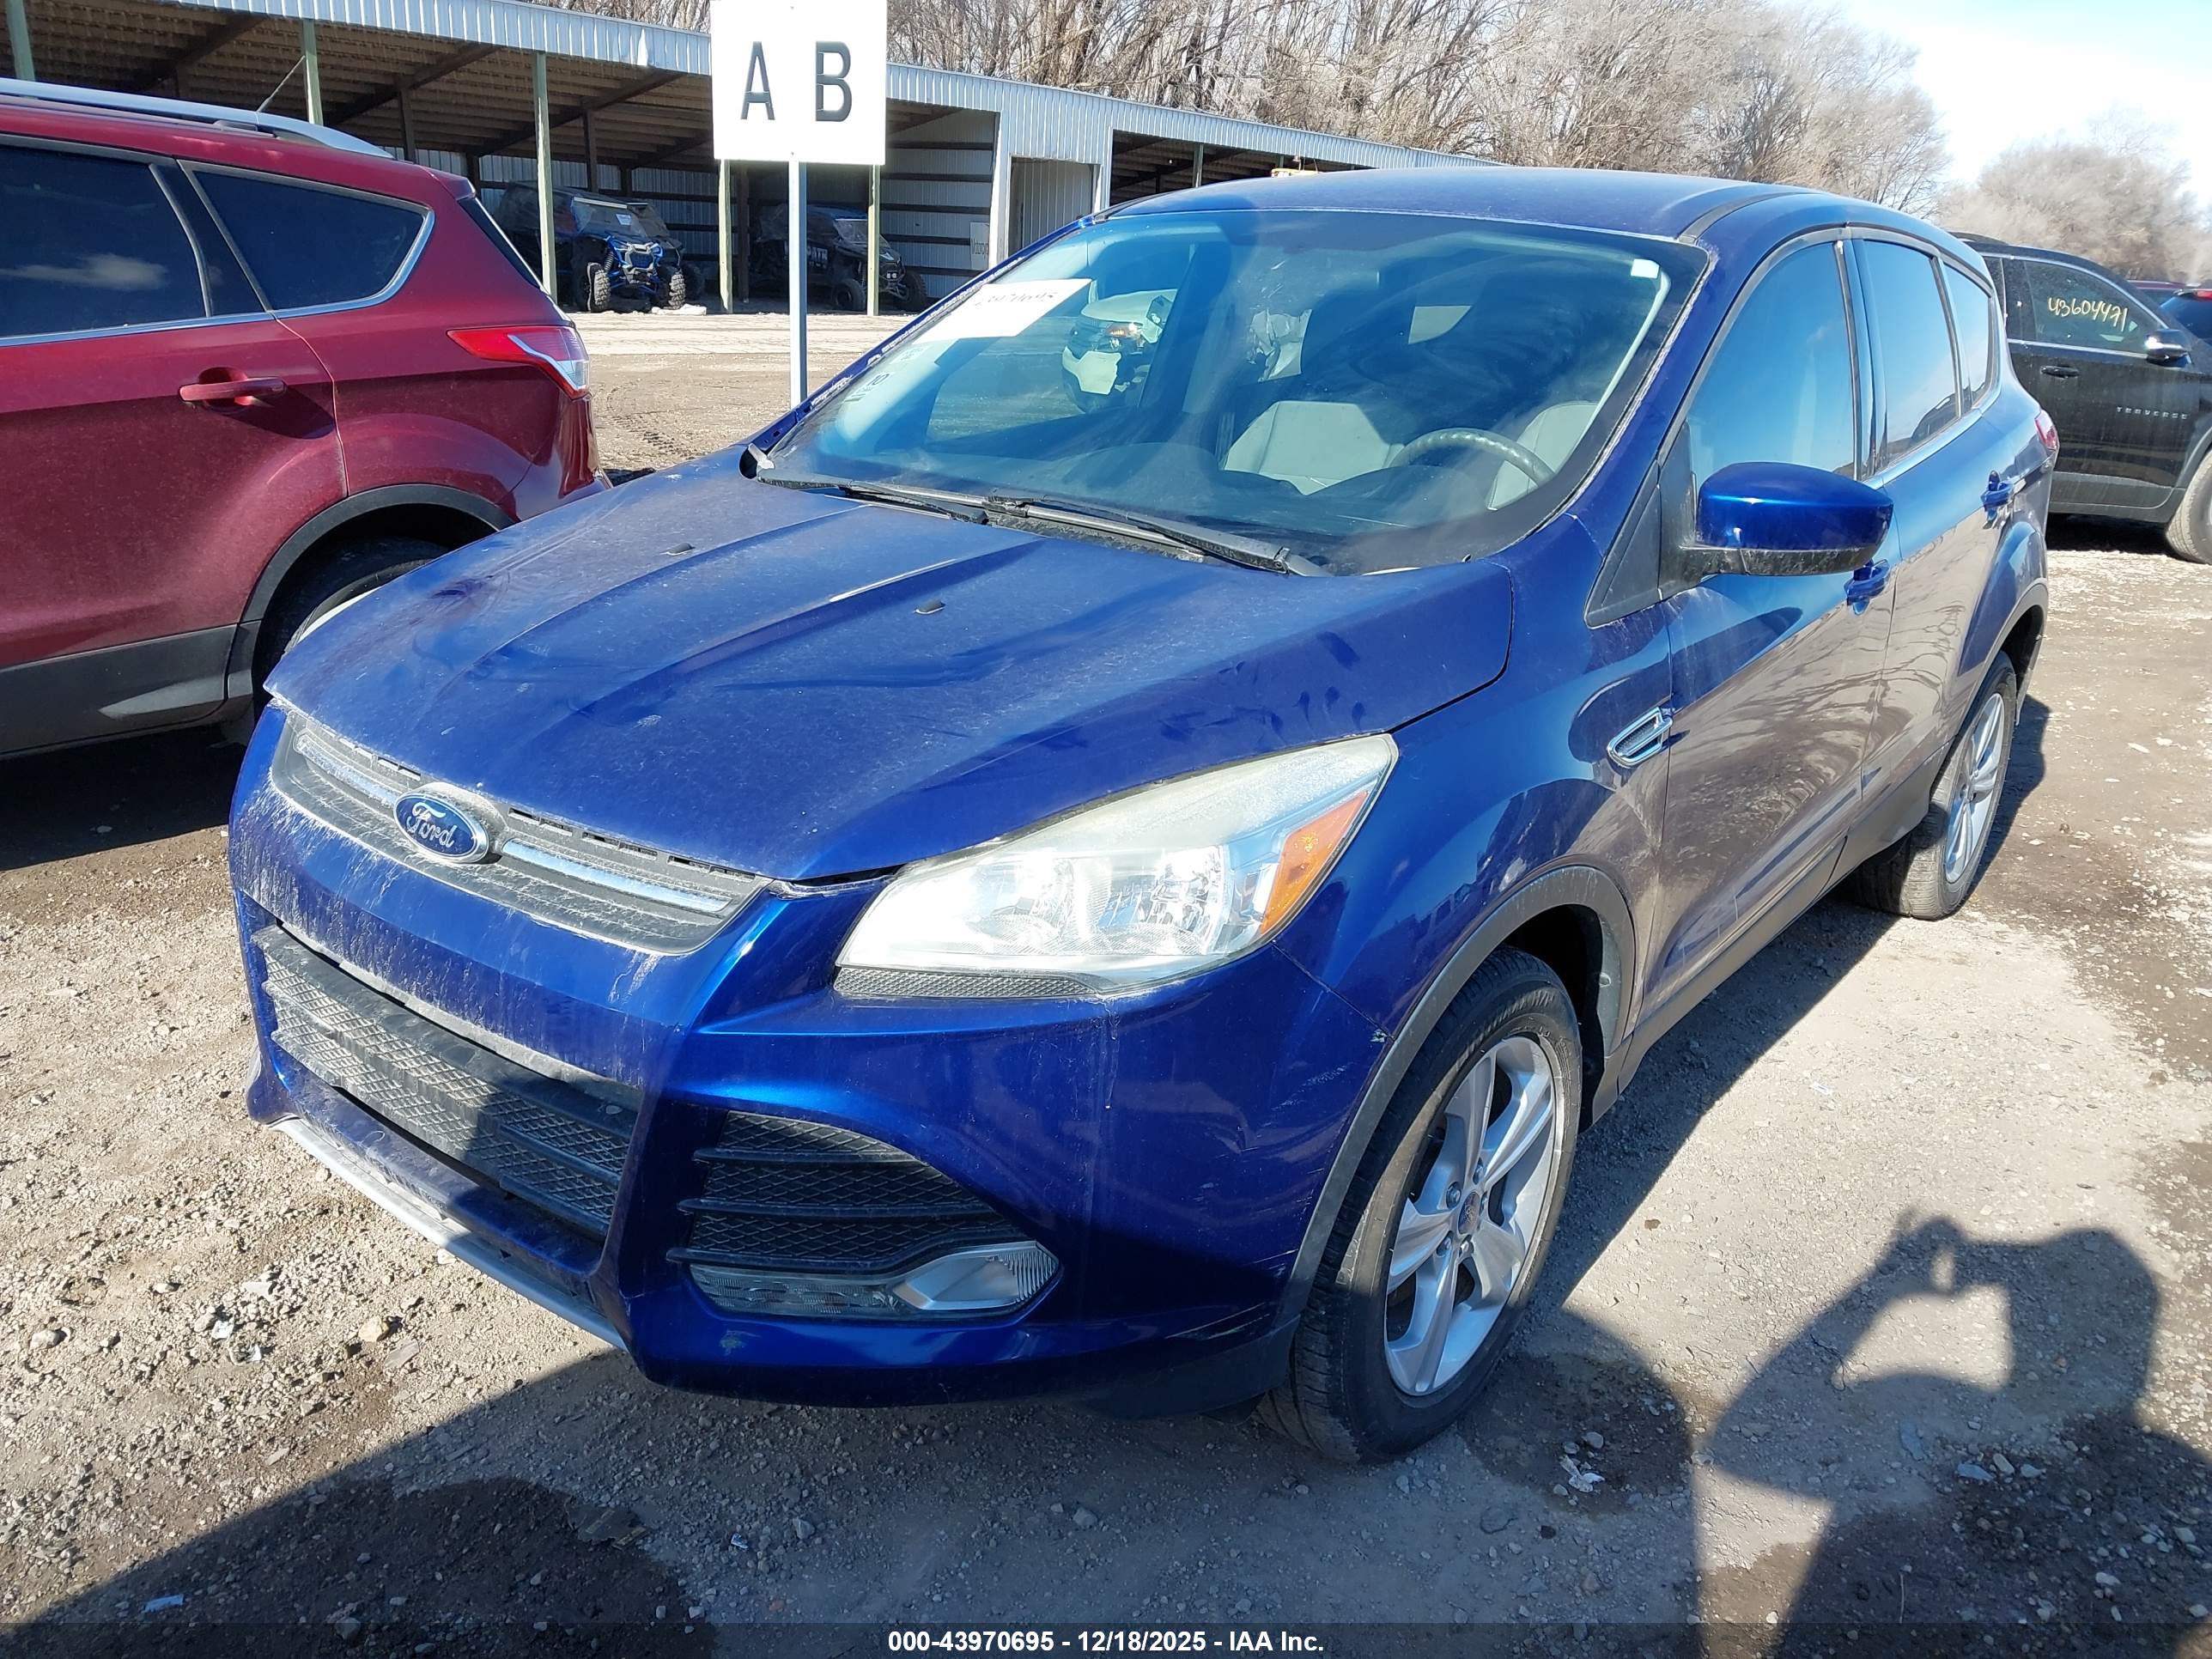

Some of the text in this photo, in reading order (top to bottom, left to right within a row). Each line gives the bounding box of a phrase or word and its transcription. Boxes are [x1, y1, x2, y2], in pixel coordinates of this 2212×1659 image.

[740, 40, 853, 122] A B
[2047, 296, 2129, 332] 43604471
[2116, 406, 2189, 420] TRAVERSE
[406, 801, 456, 848] Ford
